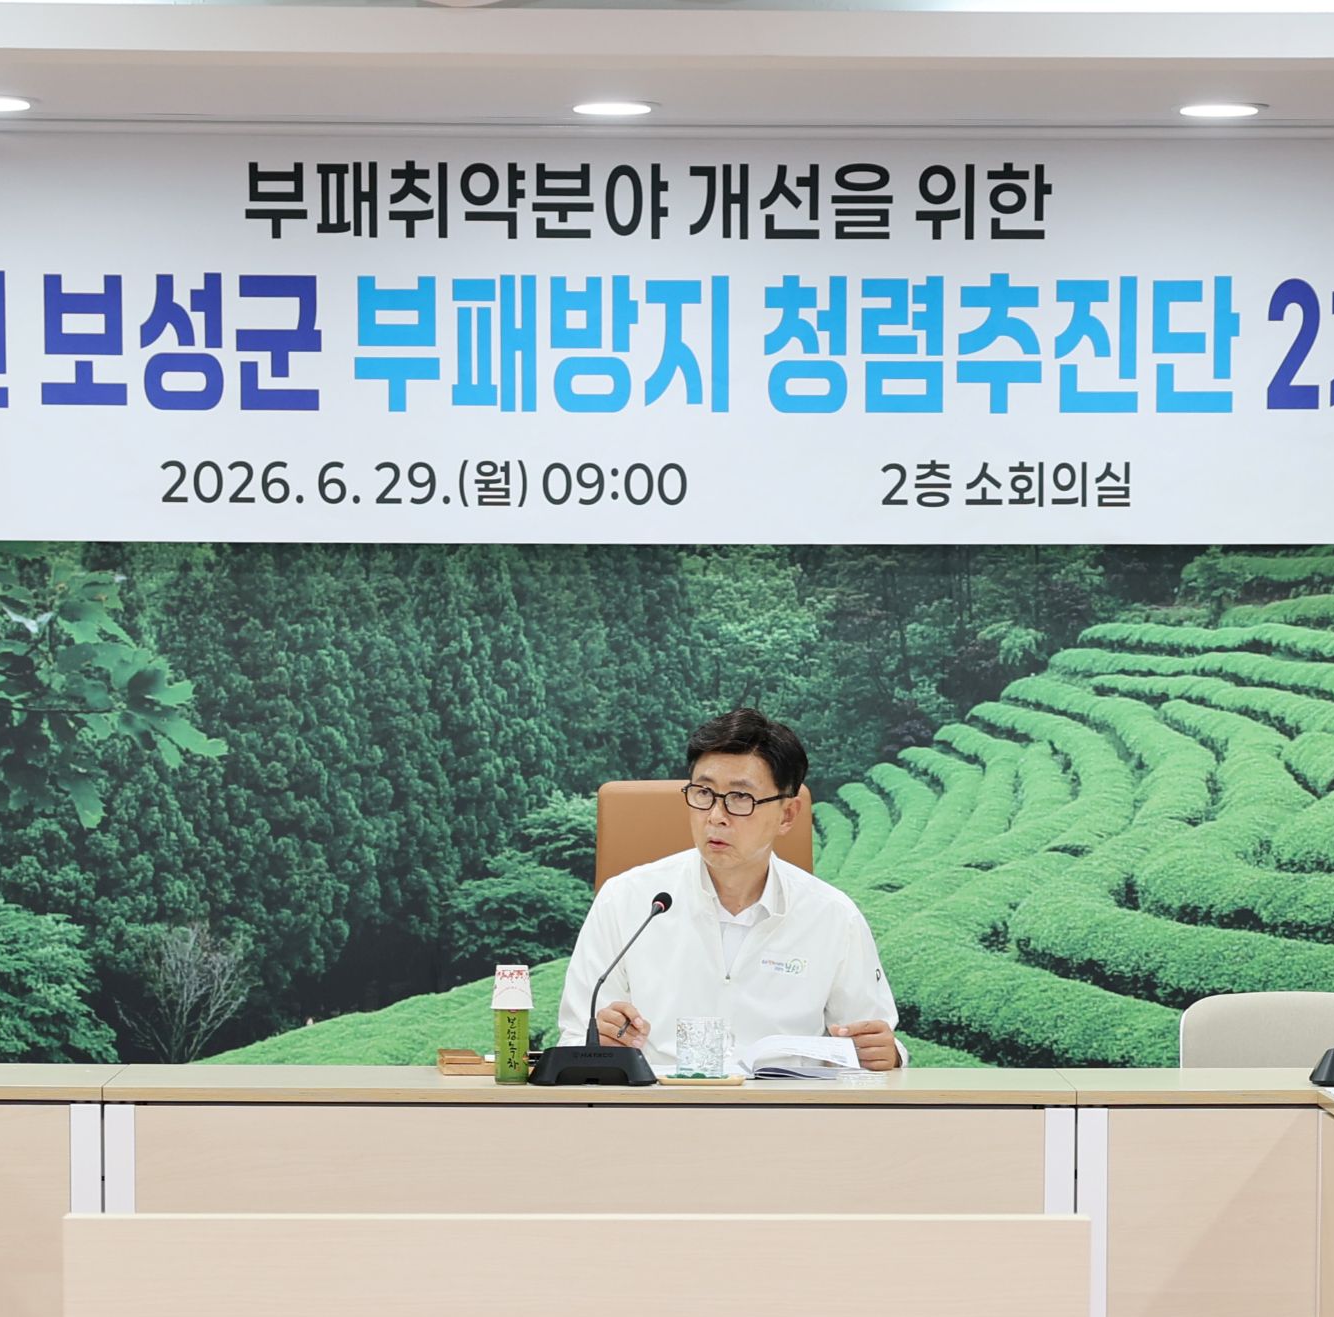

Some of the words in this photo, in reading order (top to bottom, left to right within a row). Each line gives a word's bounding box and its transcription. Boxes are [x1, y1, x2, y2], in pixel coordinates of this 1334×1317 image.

[244, 159, 669, 240] 부패취약분야
[688, 162, 894, 240] 개선을
[915, 161, 1053, 241] 위한
[41, 272, 322, 411] 보성군
[354, 274, 730, 413] 부패방지
[764, 272, 1240, 414] 청렴추진단
[542, 461, 687, 507] 09:00
[881, 460, 952, 508] 2층
[965, 461, 1131, 508] 소회의실
[506, 1016, 519, 1070] 보성녹차
